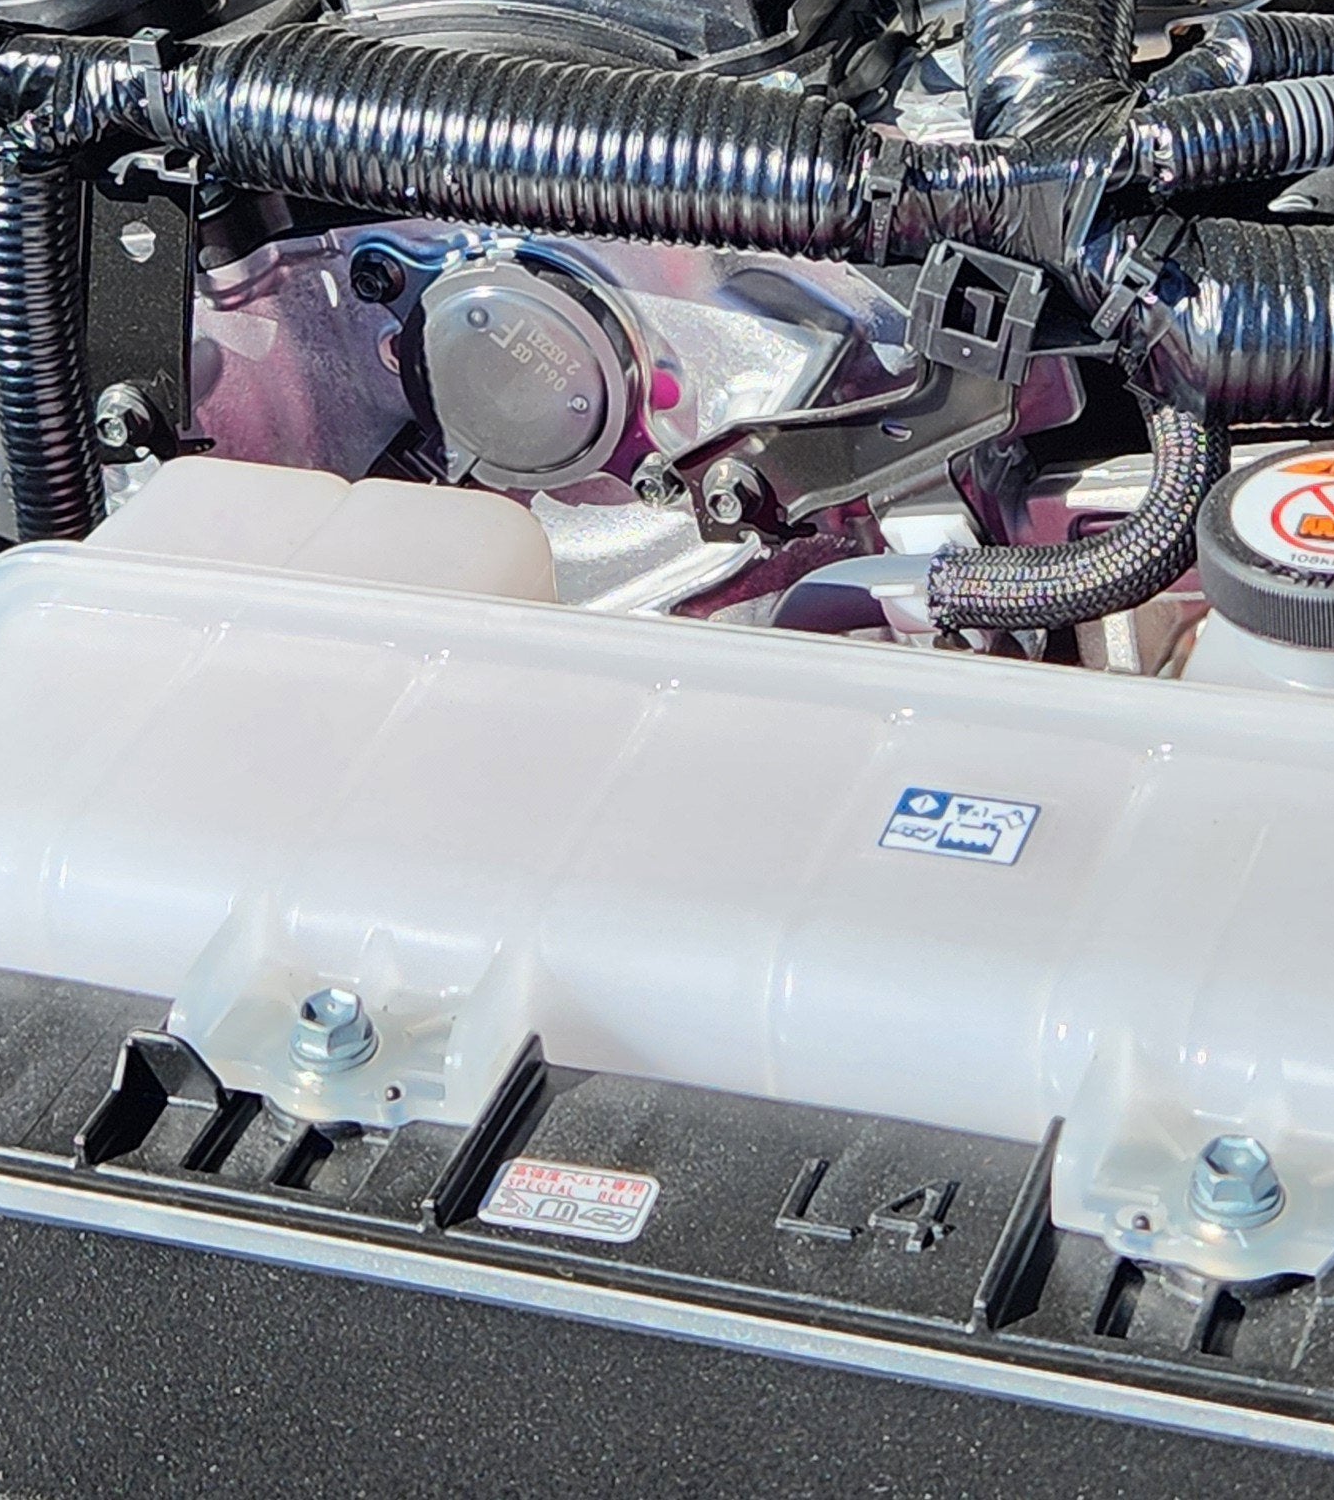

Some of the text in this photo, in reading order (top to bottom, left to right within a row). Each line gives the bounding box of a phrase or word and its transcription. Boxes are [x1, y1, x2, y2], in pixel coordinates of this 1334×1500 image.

[488, 319, 526, 349] F
[507, 1176, 640, 1205] SPECIAL BELT
[775, 1158, 962, 1252] L4
